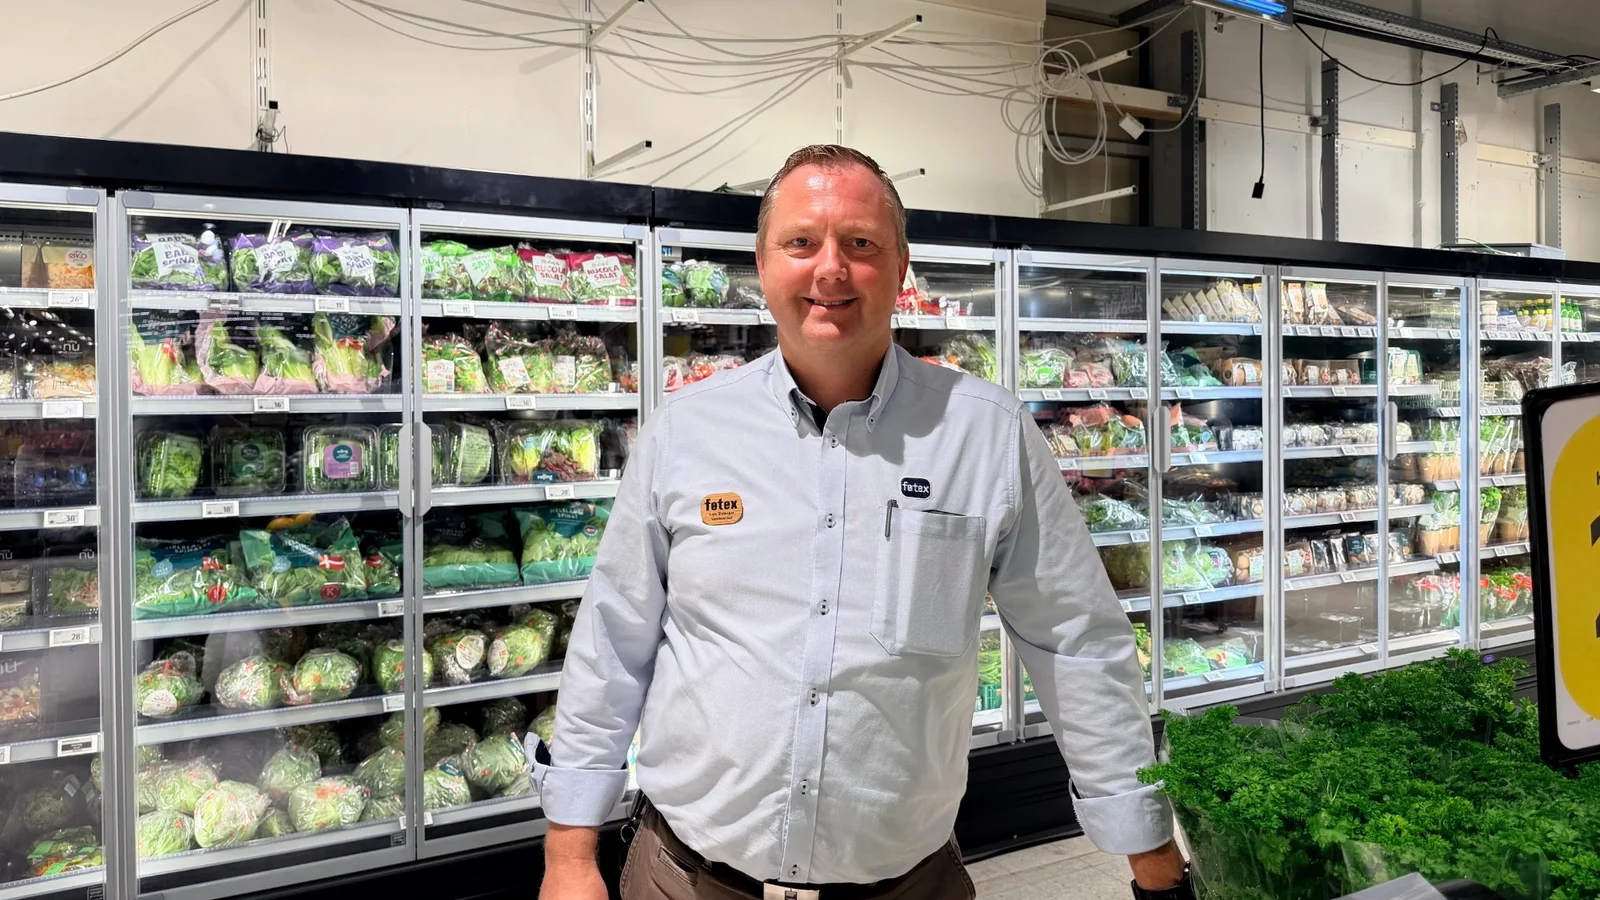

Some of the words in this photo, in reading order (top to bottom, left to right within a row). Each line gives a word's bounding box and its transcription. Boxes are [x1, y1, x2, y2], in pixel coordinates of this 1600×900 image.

[535, 265, 567, 274] RUCOLA
[587, 265, 620, 275] RUCOLA
[541, 273, 563, 281] SALAT
[902, 481, 930, 493] føtex
[704, 498, 738, 511] føtex
